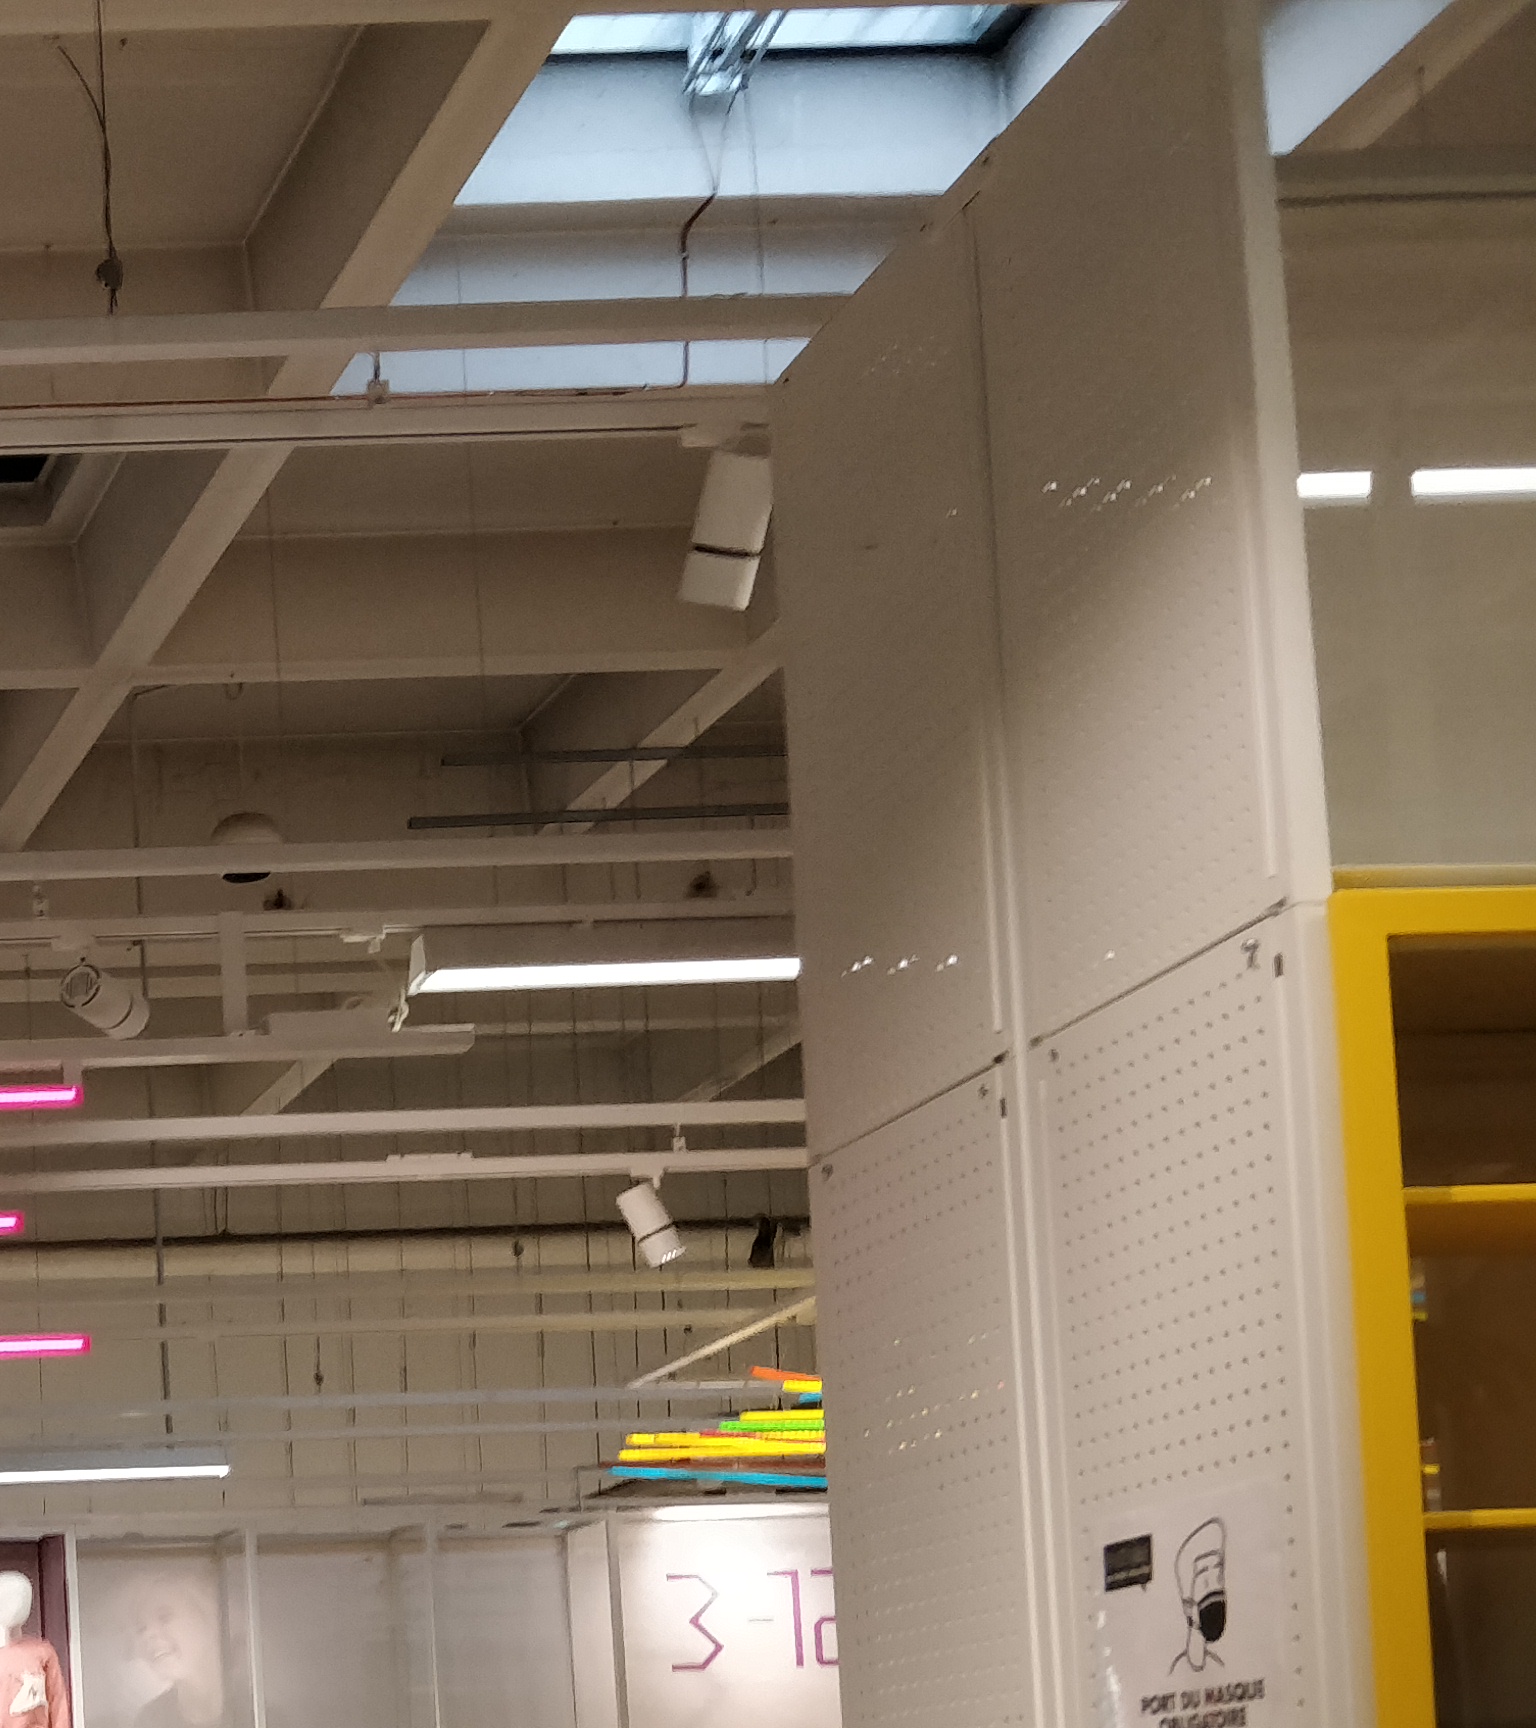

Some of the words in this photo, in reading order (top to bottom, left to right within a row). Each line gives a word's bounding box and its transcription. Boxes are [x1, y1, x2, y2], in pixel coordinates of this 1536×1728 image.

[1141, 1691, 1175, 1714] PORT
[1180, 1688, 1201, 1710] DU
[1204, 1678, 1266, 1706] MASQUE
